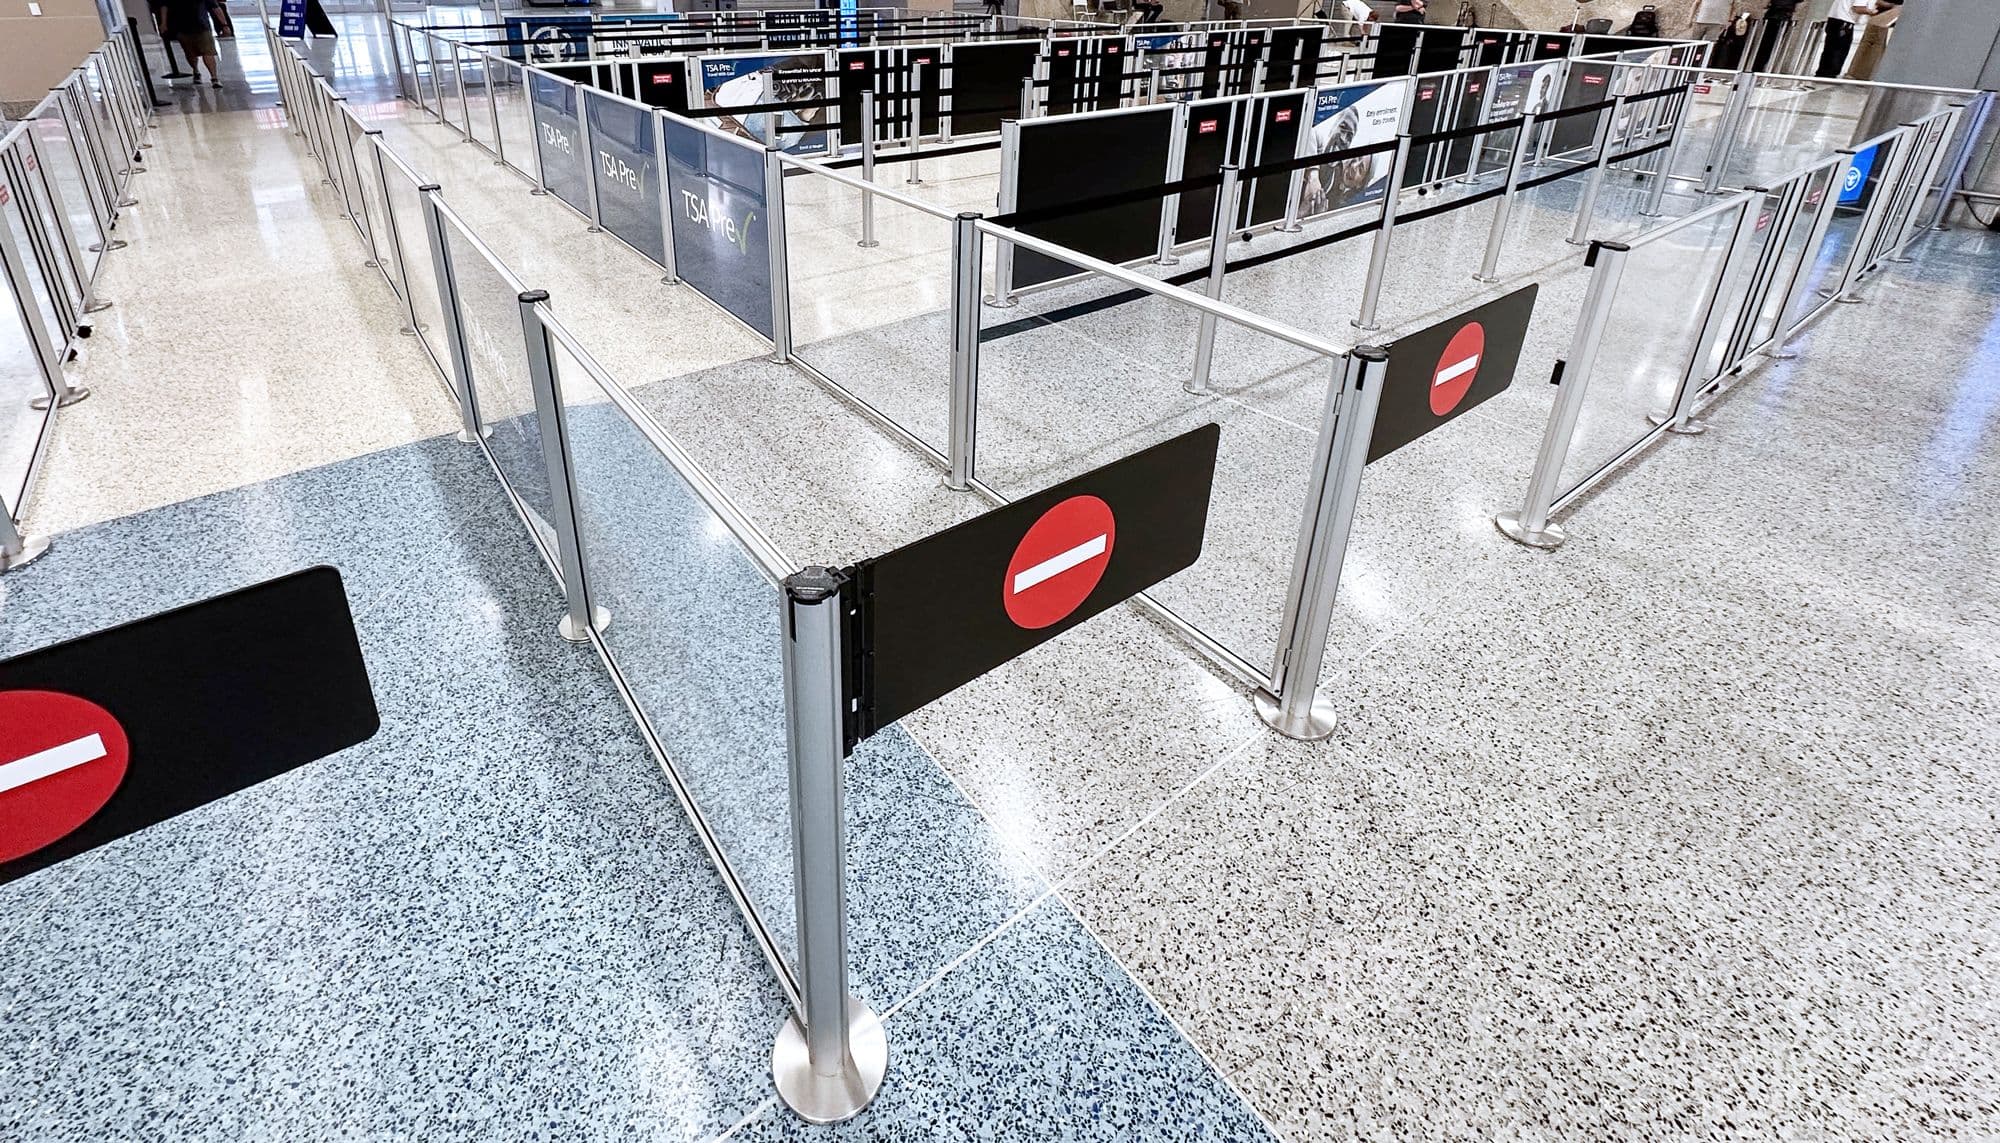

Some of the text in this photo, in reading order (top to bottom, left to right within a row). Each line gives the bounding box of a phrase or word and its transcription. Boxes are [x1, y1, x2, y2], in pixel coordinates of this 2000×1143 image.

[705, 63, 731, 73] TSA Pre
[1318, 95, 1338, 106] TSA Pre
[542, 122, 570, 153] TSA Pre
[600, 151, 638, 190] TSA Pre
[682, 189, 736, 242] TSA Pre
